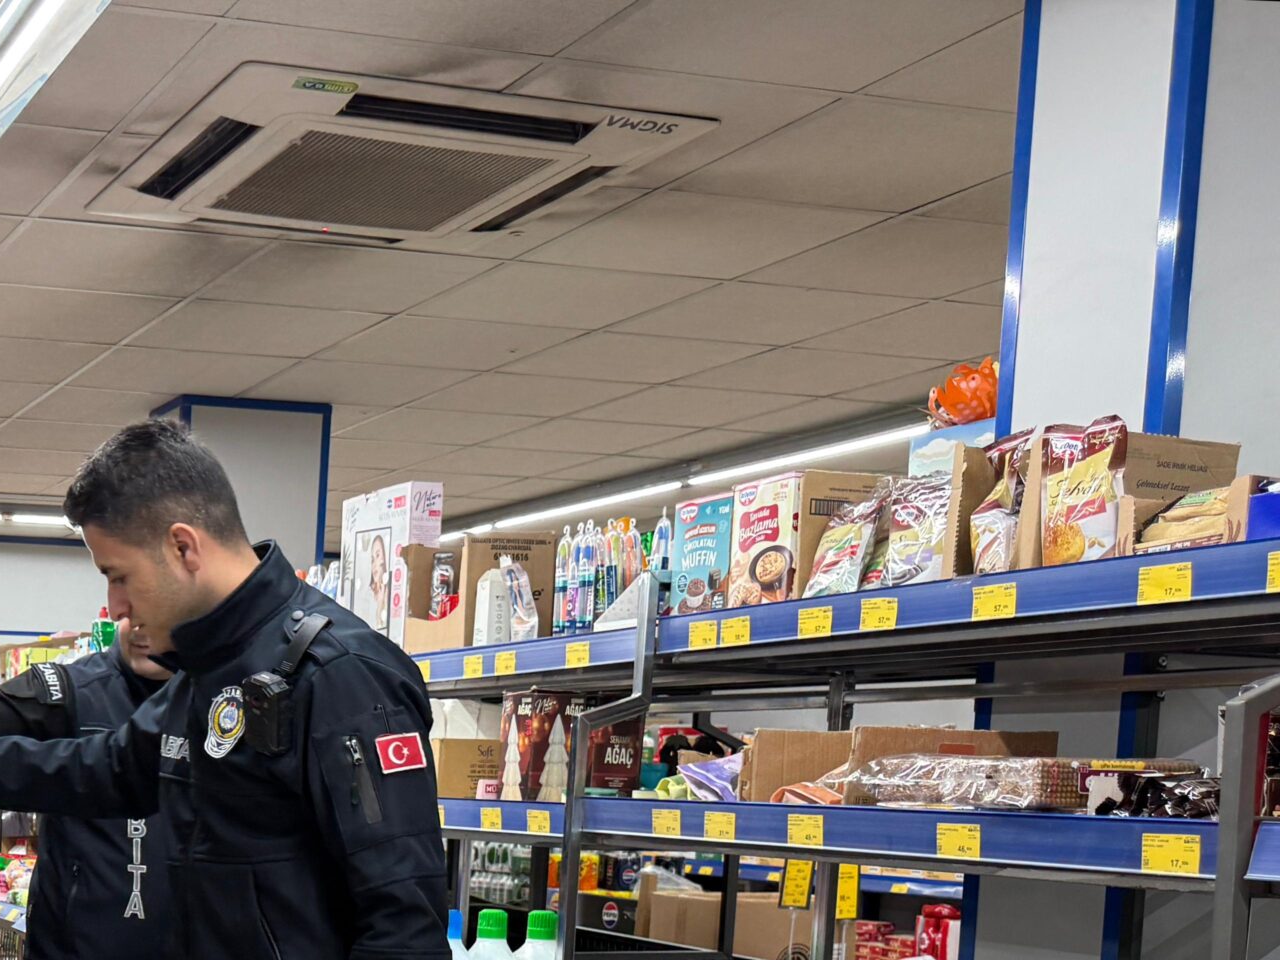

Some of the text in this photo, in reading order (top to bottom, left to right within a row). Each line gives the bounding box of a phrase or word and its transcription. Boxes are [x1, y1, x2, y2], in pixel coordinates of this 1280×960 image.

[606, 114, 678, 136] SIGMA
[739, 517, 778, 542] Bazlama
[38, 662, 63, 701] ZABITA
[604, 747, 634, 769] AĞAÇ
